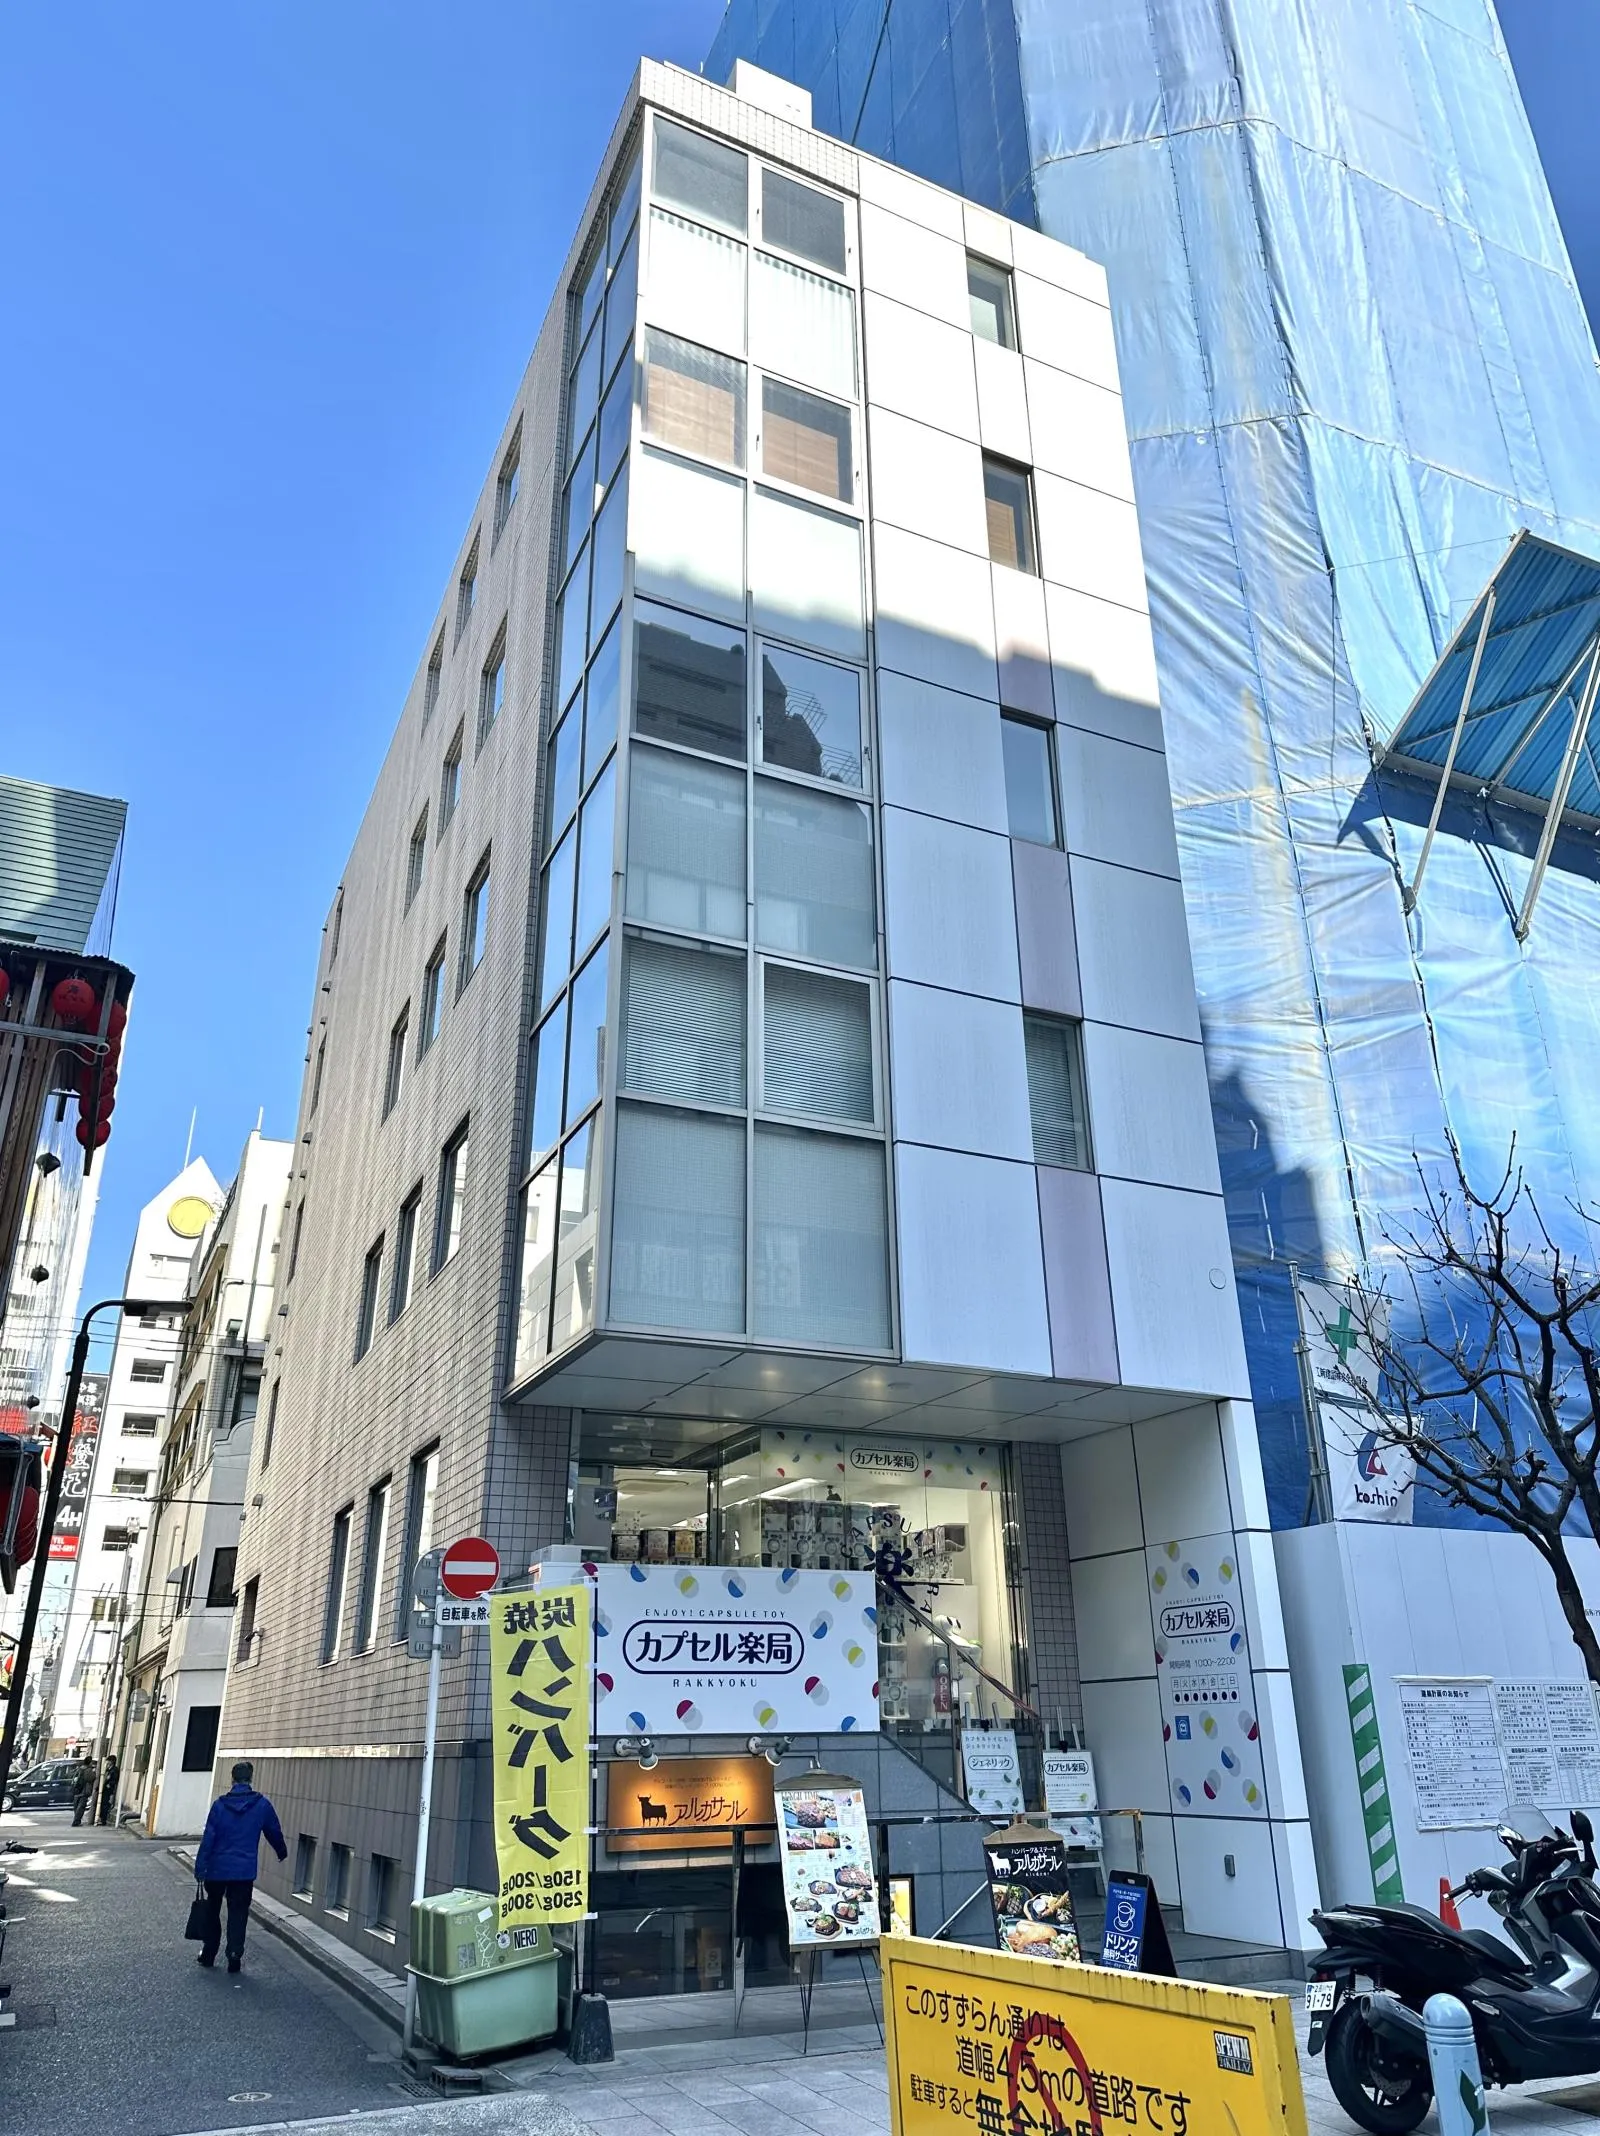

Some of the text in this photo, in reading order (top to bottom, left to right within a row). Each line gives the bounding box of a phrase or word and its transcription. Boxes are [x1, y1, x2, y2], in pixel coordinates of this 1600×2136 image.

[855, 1453, 914, 1469] カプセル楽局
[1354, 1484, 1398, 1507] koshin
[645, 1608, 786, 1619] ENJOY! CAPSULE TOY
[1165, 1607, 1230, 1632] カプセル楽局
[635, 1630, 793, 1665] カプセル楽局
[672, 1678, 758, 1688] RAKKYOKU
[940, 1676, 949, 1709] OPEN
[970, 1757, 1011, 1768] ジェネリック
[1047, 1761, 1086, 1773] カプセル楽局
[668, 1796, 749, 1827] アルカサール
[1012, 1853, 1063, 1875] アルカサール
[514, 1928, 538, 1949] NERO
[1105, 1933, 1139, 1953] ドリンク
[906, 1985, 1066, 2050] このすずらん通りは
[955, 2034, 1191, 2136] 道幅4.5mの道路です
[910, 2074, 976, 2119] 駐車すると
